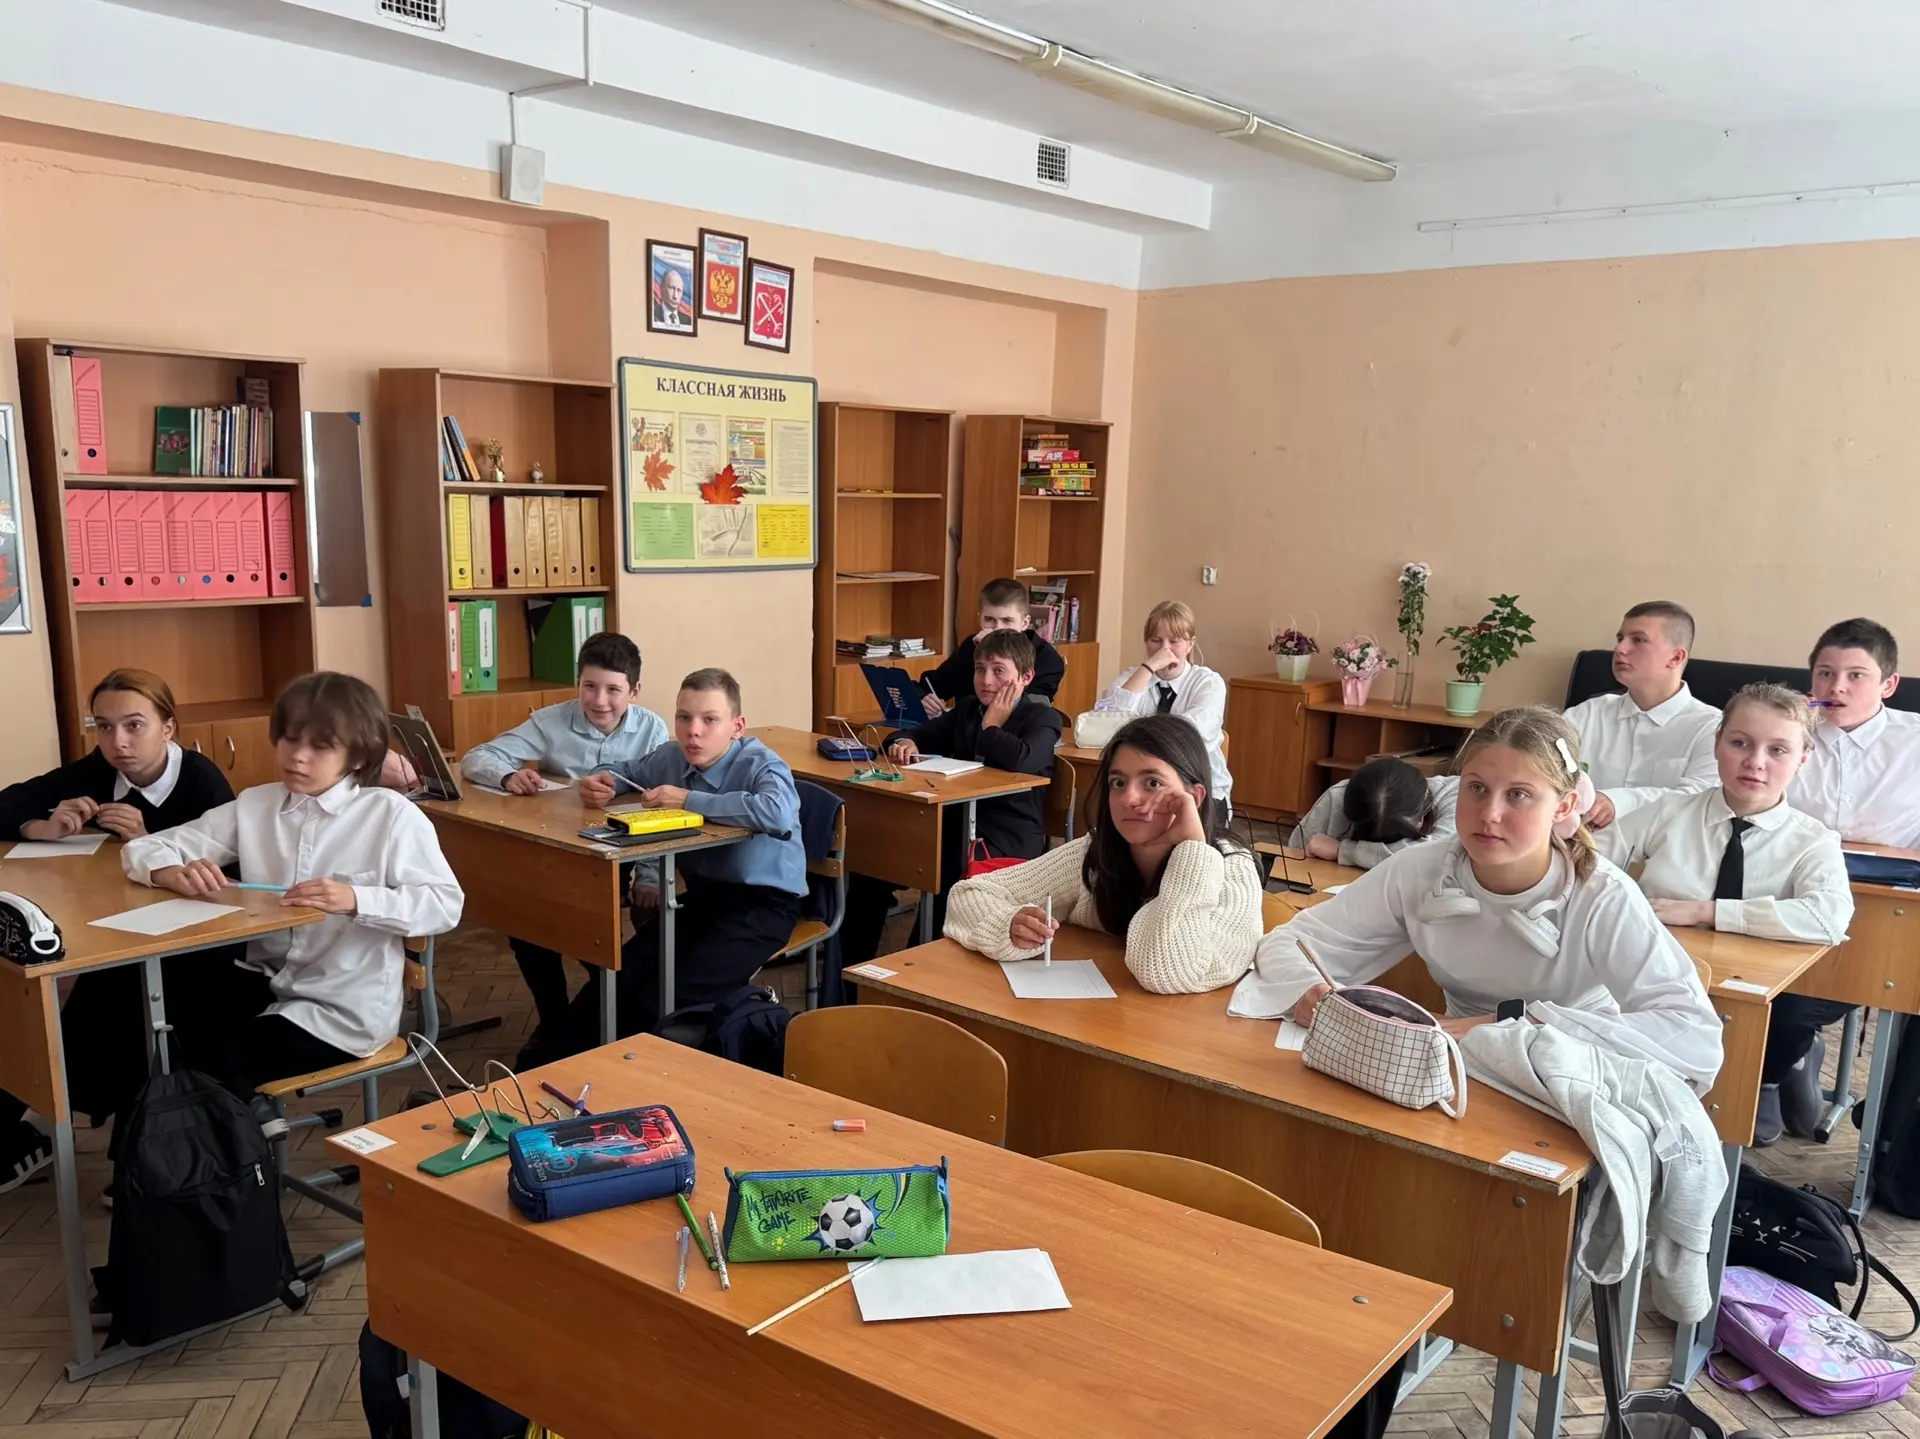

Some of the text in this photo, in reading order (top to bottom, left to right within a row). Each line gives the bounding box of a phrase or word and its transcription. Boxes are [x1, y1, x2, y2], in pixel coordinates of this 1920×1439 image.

[656, 377, 787, 403] КЛАССНАЯ ЖИЗНЬ
[760, 1187, 813, 1214] FAVORITE
[758, 1210, 797, 1234] GAME
